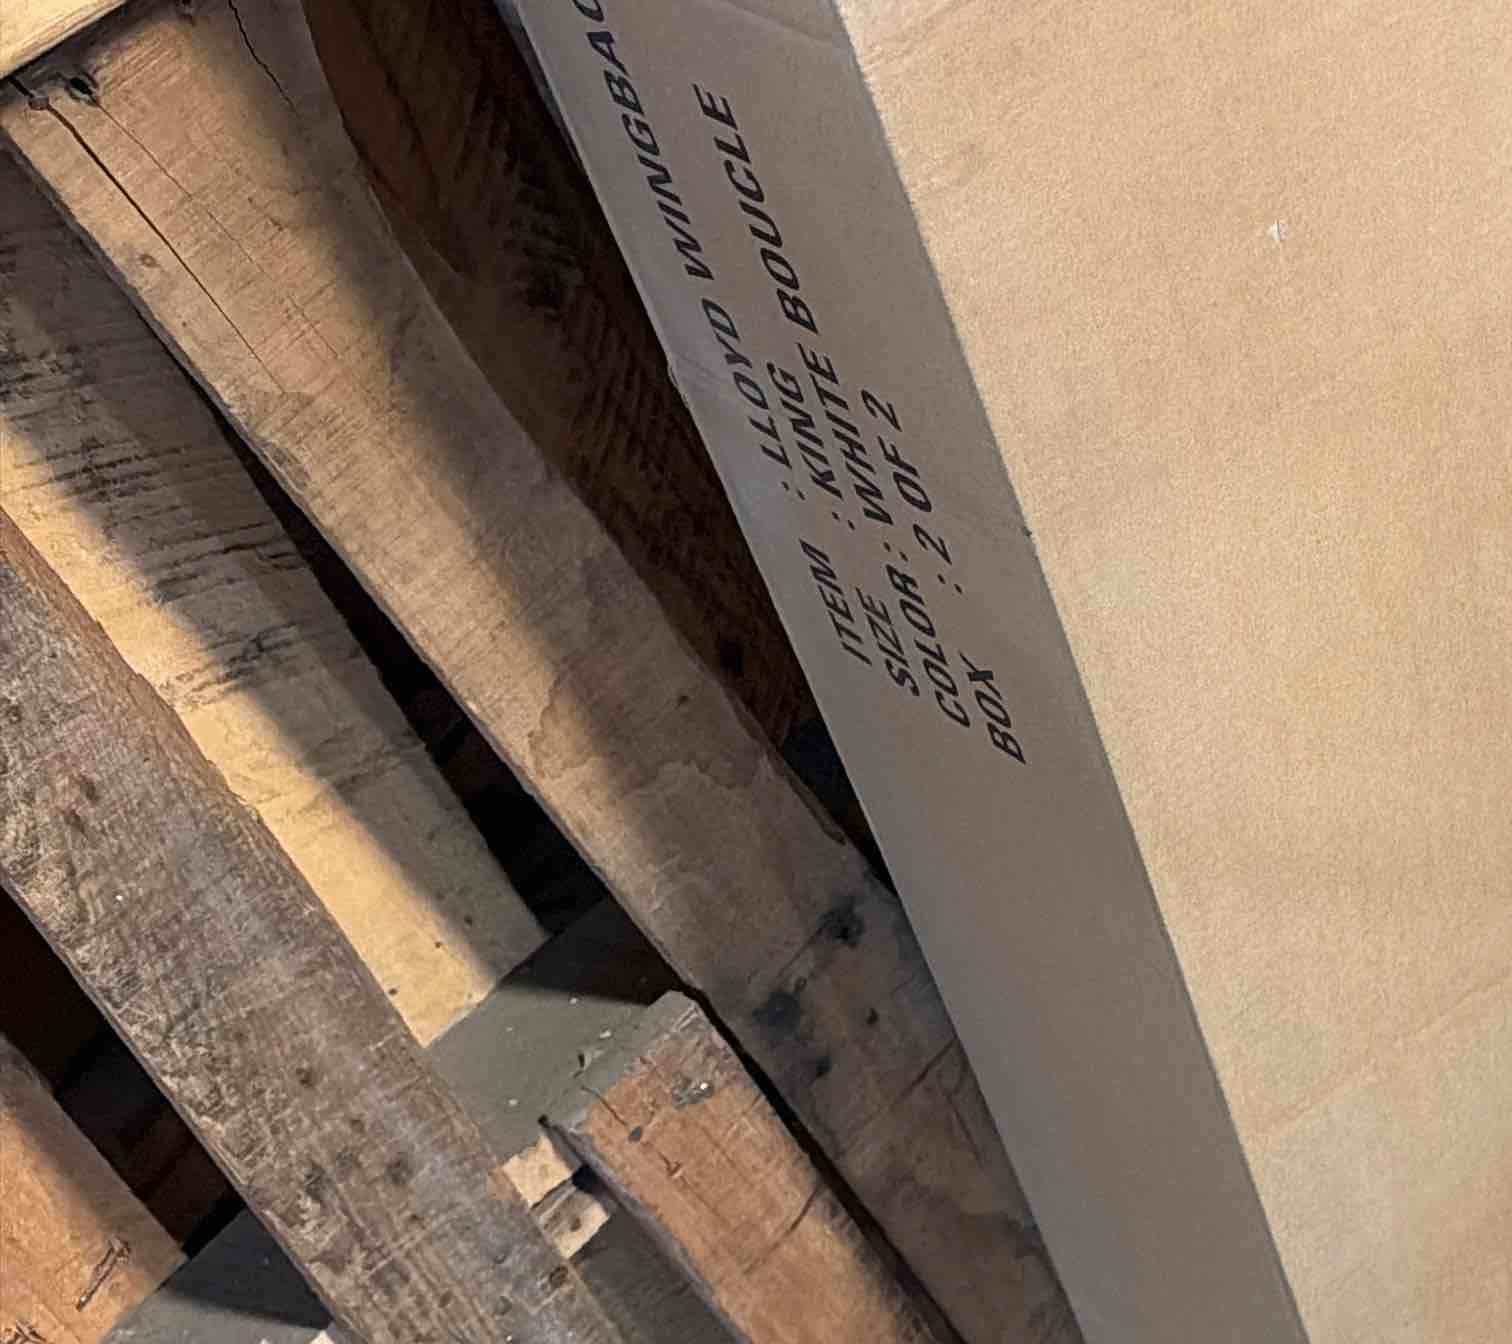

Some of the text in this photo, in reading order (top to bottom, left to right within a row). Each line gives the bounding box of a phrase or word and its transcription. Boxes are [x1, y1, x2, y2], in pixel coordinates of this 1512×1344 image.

[692, 83, 818, 334] BOUCLE
[702, 297, 791, 469] LLOYD
[766, 362, 843, 499] KING
[798, 342, 893, 525] WHITE
[861, 389, 902, 432] 2
[877, 437, 931, 512] OF
[800, 539, 872, 666] ITEM
[913, 524, 951, 565] 2
[856, 588, 920, 696] SIZE
[960, 653, 1025, 764] BOX
